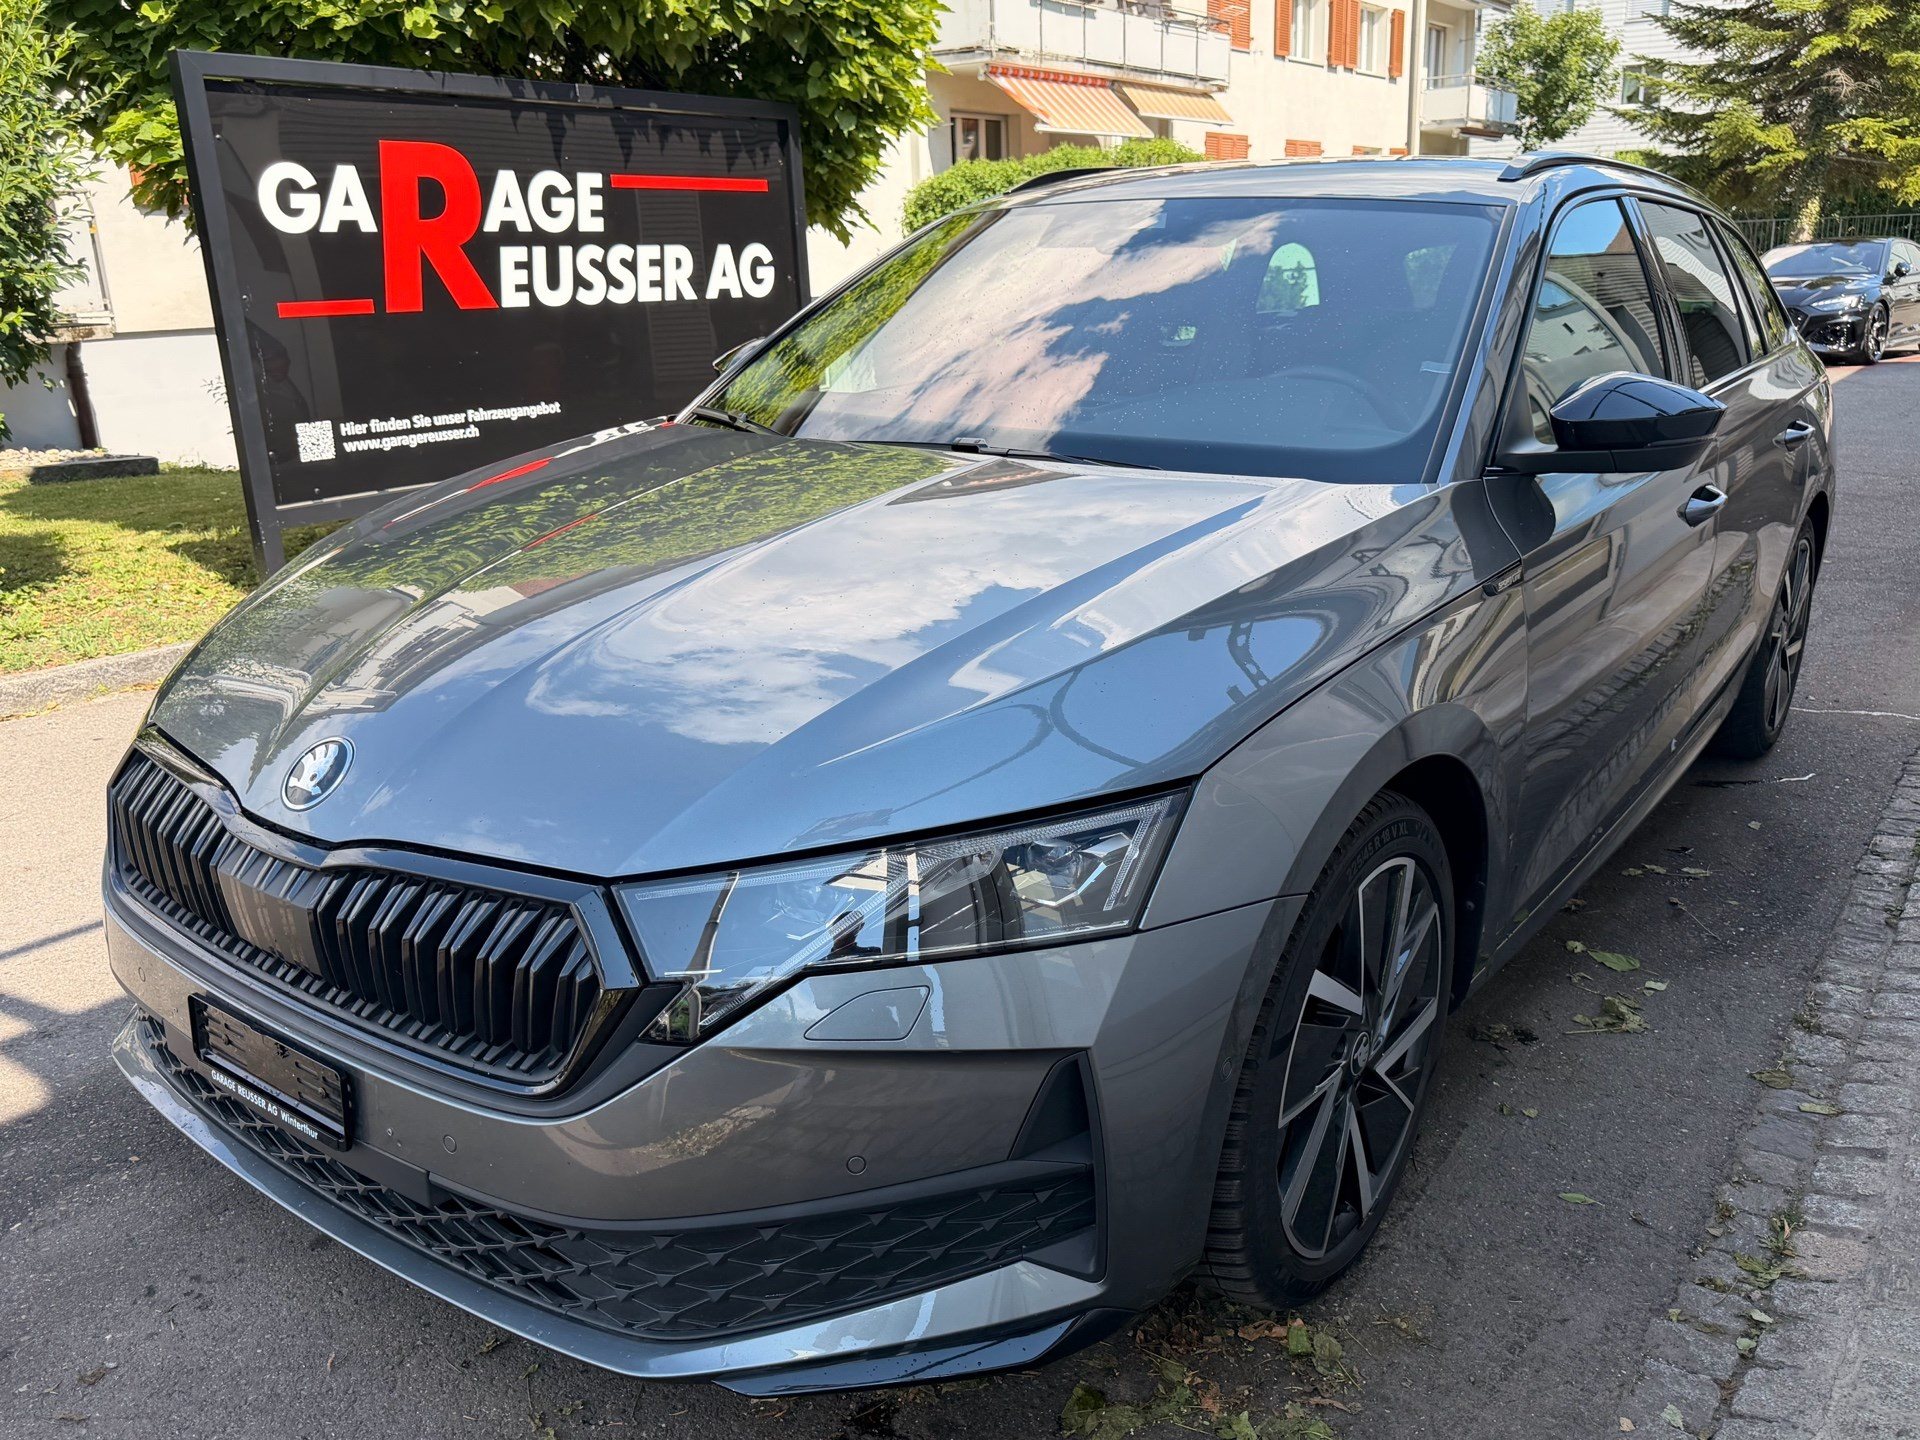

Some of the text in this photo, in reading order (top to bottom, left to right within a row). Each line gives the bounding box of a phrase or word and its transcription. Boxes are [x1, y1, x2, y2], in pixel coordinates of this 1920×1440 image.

[257, 139, 604, 313] GARAGE
[705, 242, 776, 300] AG
[339, 401, 562, 437] Hier finden Sie unser Fahrzeugangebot
[343, 424, 480, 453] www.garagereusser.ch
[211, 1069, 318, 1140] GARAGE REUSSER AG Winterthur
